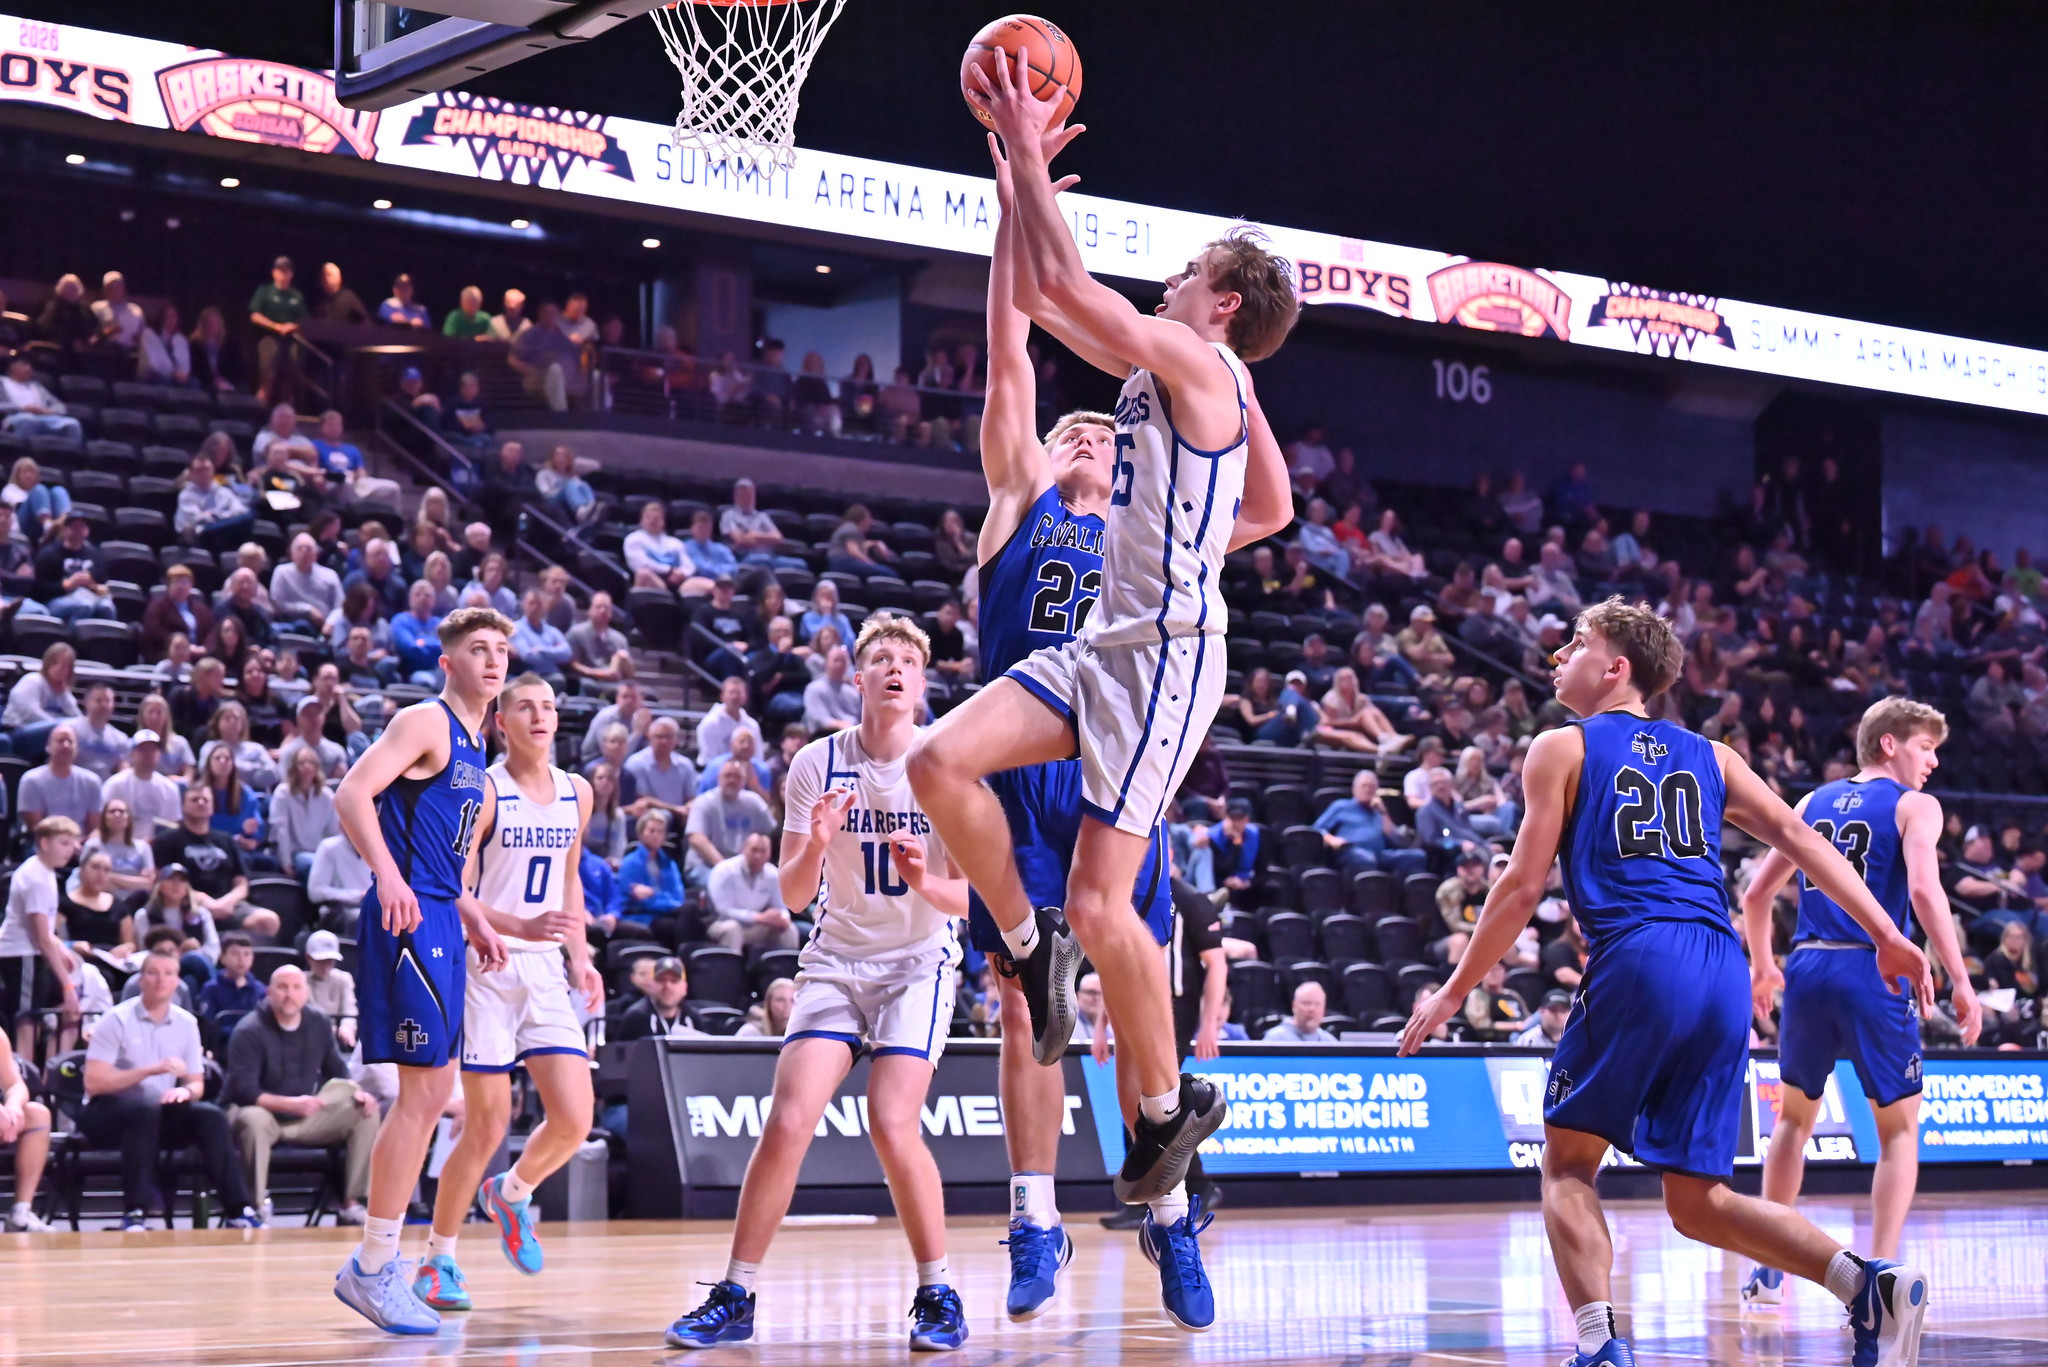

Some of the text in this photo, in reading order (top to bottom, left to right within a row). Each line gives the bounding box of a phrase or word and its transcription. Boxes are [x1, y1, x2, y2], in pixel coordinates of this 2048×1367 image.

[433, 108, 607, 159] CHAMPIONSHIP
[656, 143, 790, 200] SUMMIT
[815, 169, 924, 221] ARENA
[1073, 211, 1150, 256] 19-21
[1296, 260, 1411, 312] BOYS
[1432, 359, 1492, 404] 106
[1111, 433, 1136, 507] 5
[1030, 512, 1105, 558] CAVALI
[1028, 559, 1102, 637] 22
[840, 808, 931, 836] HARGERS
[1615, 765, 1708, 859] 20
[523, 855, 552, 904] 0
[861, 841, 909, 897] 10
[1192, 1072, 1428, 1101] THOPEDICS AND
[1922, 1074, 2044, 1099] RTHOPEDICS
[703, 1096, 1082, 1137] MNMET
[1217, 1101, 1430, 1129] ORTS MEDICINE
[1917, 1099, 2048, 1124] PORTS MEDI
[1223, 1137, 1416, 1155] MONUMENT HEALTH
